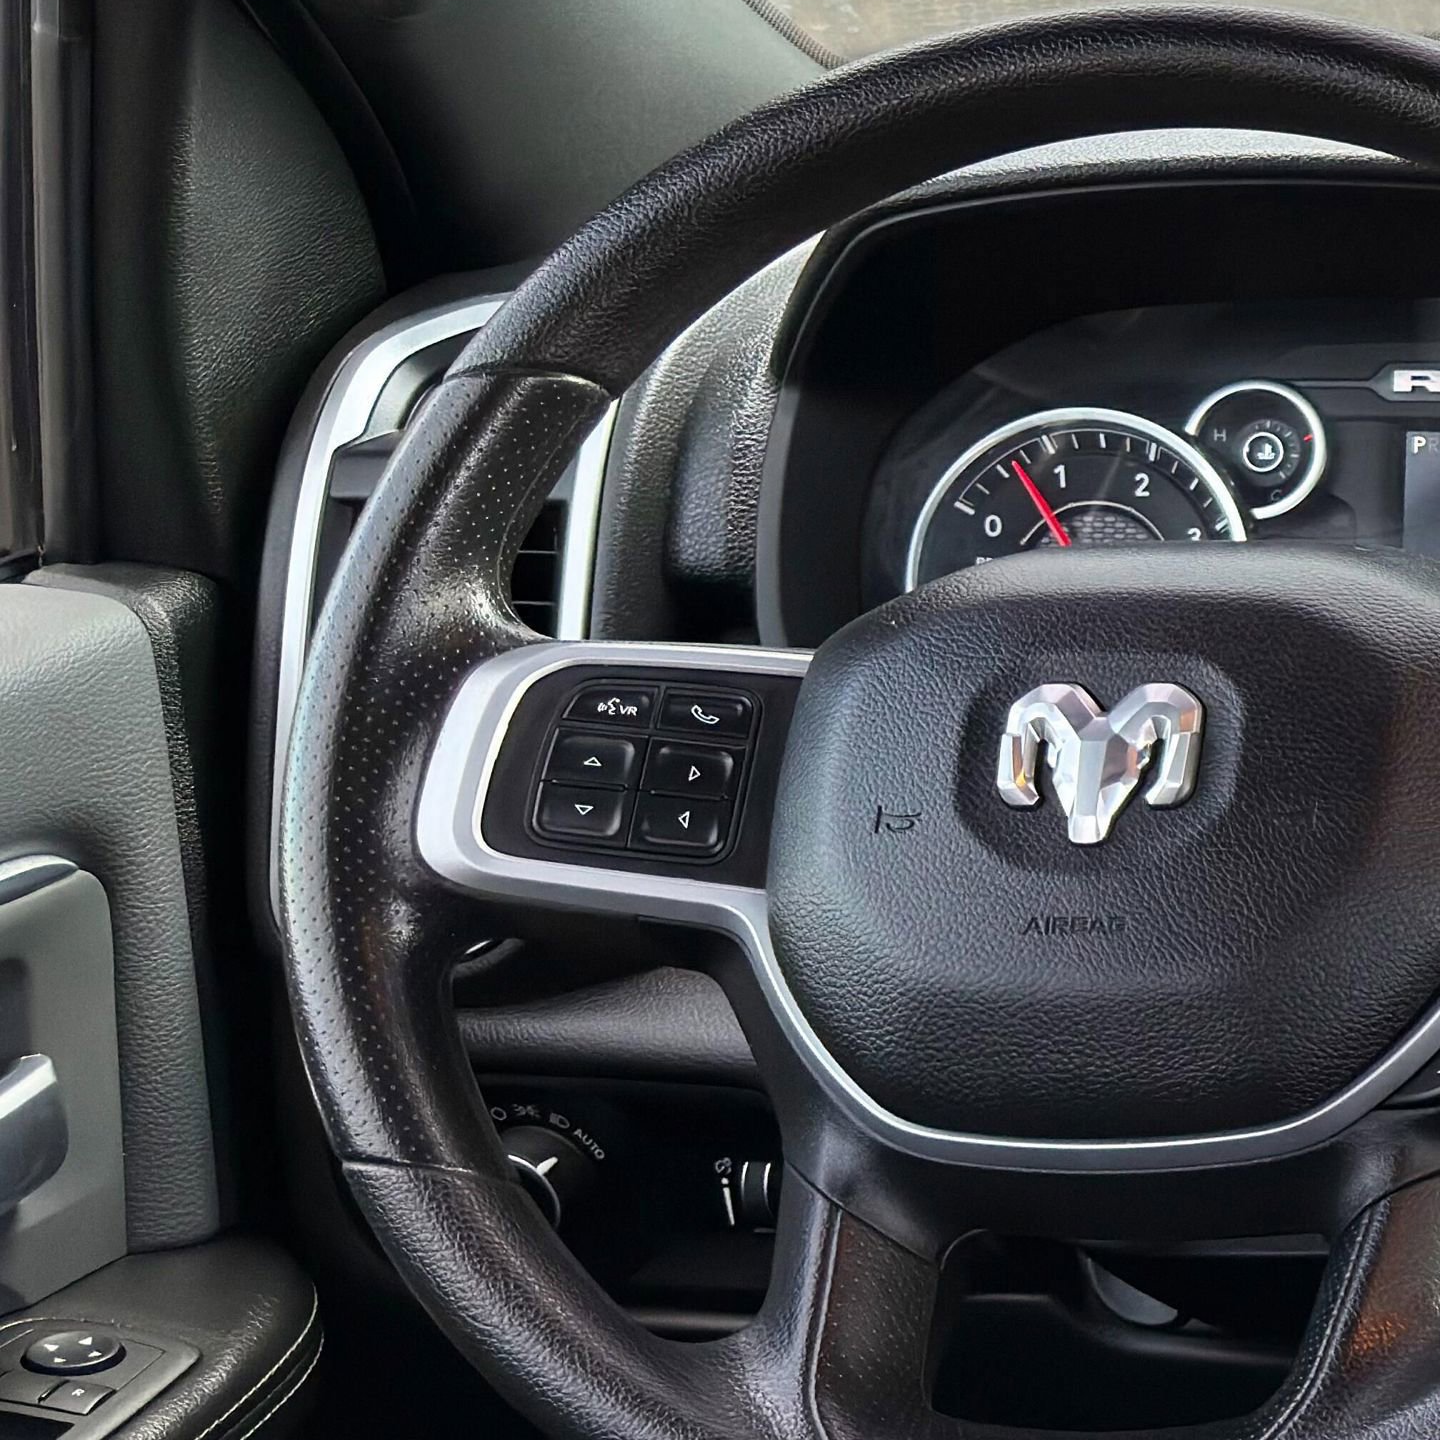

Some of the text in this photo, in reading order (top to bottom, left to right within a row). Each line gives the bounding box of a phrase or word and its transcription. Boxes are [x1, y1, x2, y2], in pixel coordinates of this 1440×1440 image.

[1213, 428, 1227, 442] H
[1053, 464, 1067, 489] 1
[1134, 473, 1150, 498] 2
[984, 515, 1003, 538] 0
[619, 704, 638, 716] VR
[572, 1127, 606, 1161] AUTO
